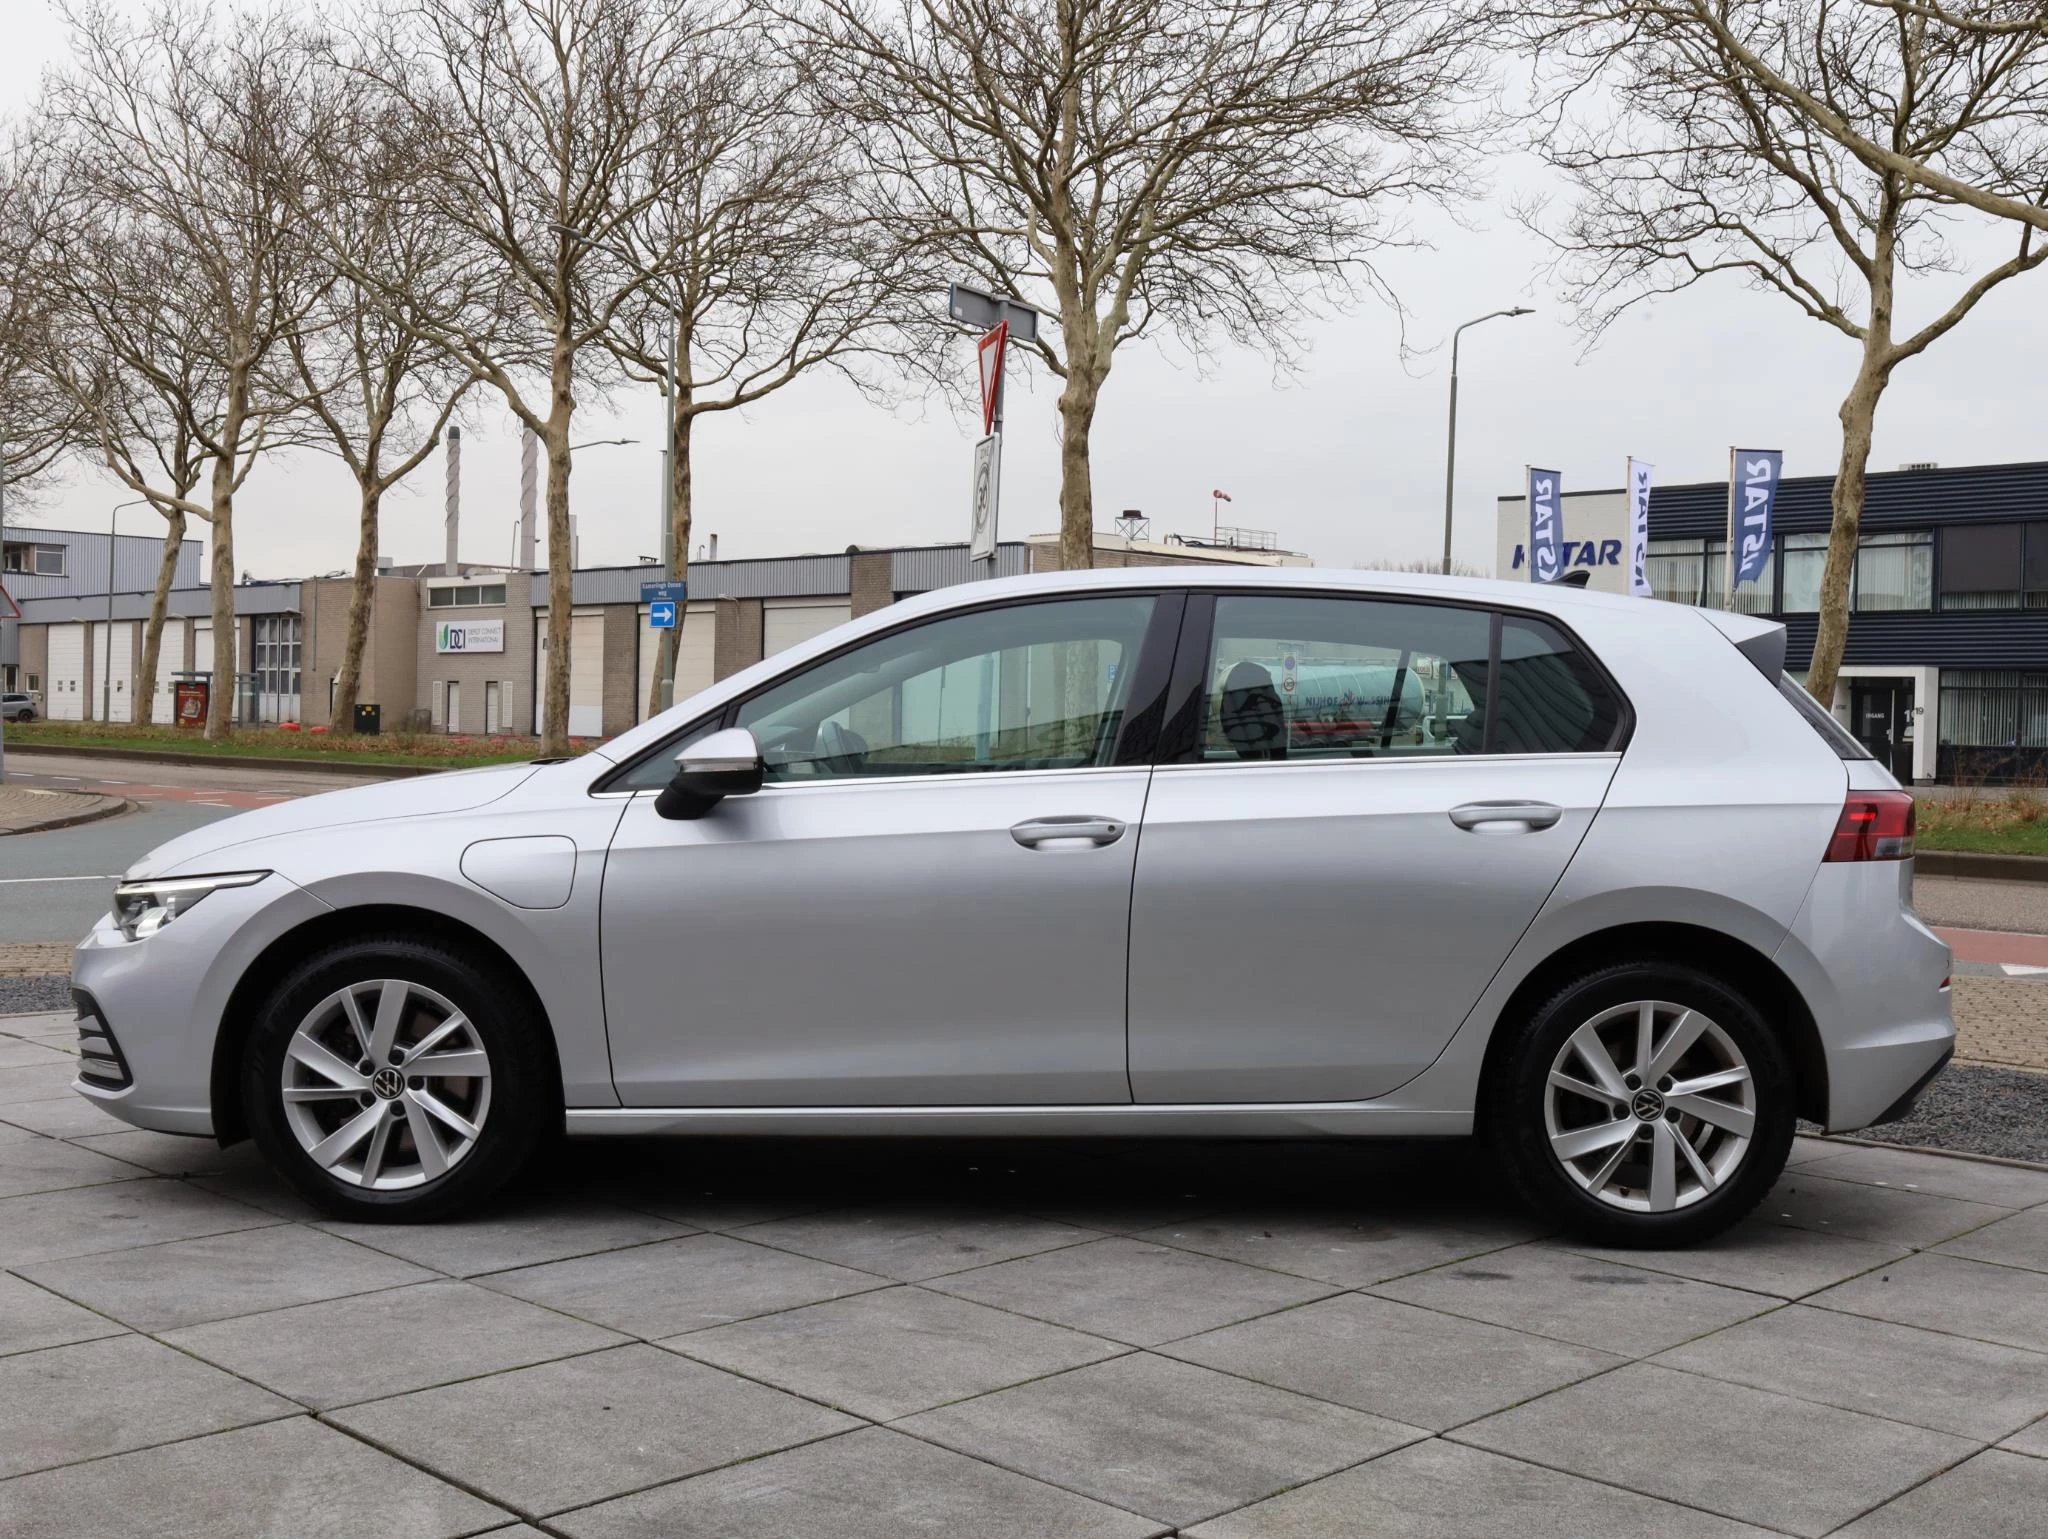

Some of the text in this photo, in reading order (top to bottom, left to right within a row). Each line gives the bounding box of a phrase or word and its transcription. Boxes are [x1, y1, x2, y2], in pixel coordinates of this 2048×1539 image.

[977, 486, 988, 512] 30
[1512, 539, 1622, 569] KTAR
[449, 628, 466, 649] DCI
[1915, 707, 1924, 715] 19
